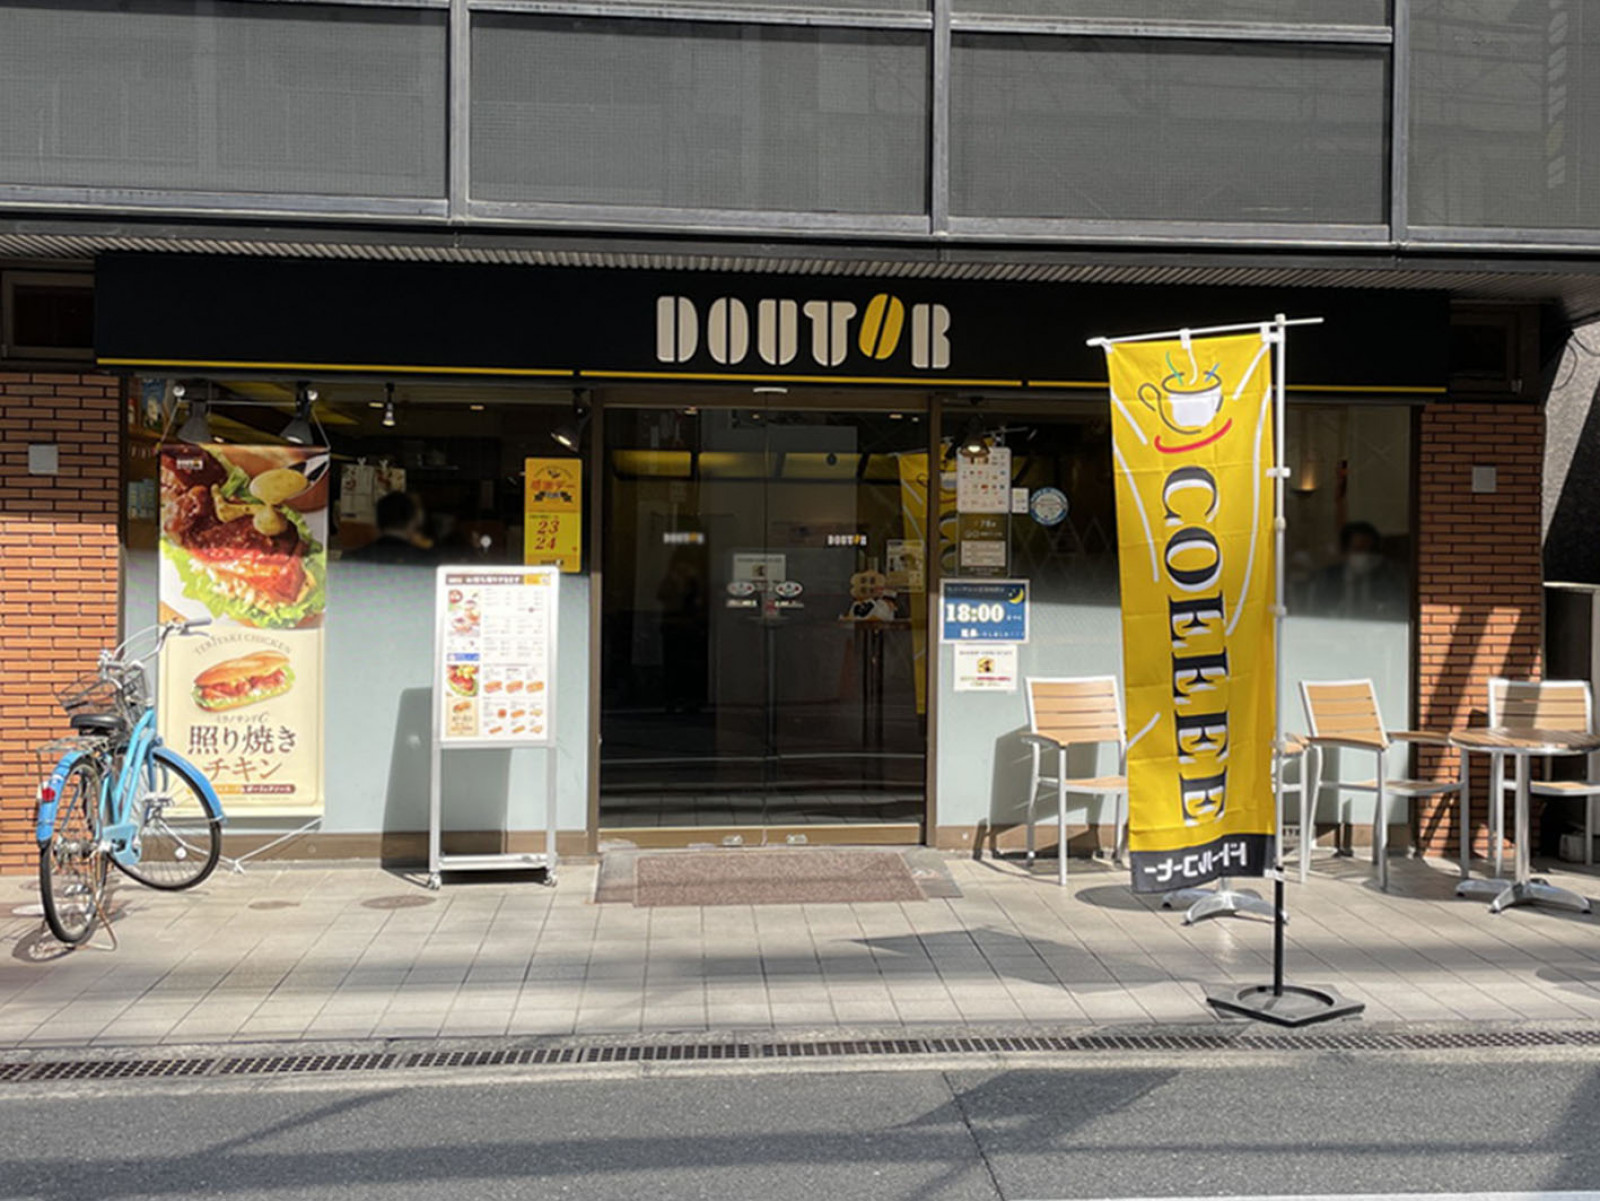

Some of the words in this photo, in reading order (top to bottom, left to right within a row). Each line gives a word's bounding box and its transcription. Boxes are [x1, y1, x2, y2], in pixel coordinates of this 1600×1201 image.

[656, 293, 951, 369] DOUTOR
[946, 603, 1005, 623] 18:00
[188, 725, 297, 754] 照り焼き
[203, 756, 283, 783] チキン
